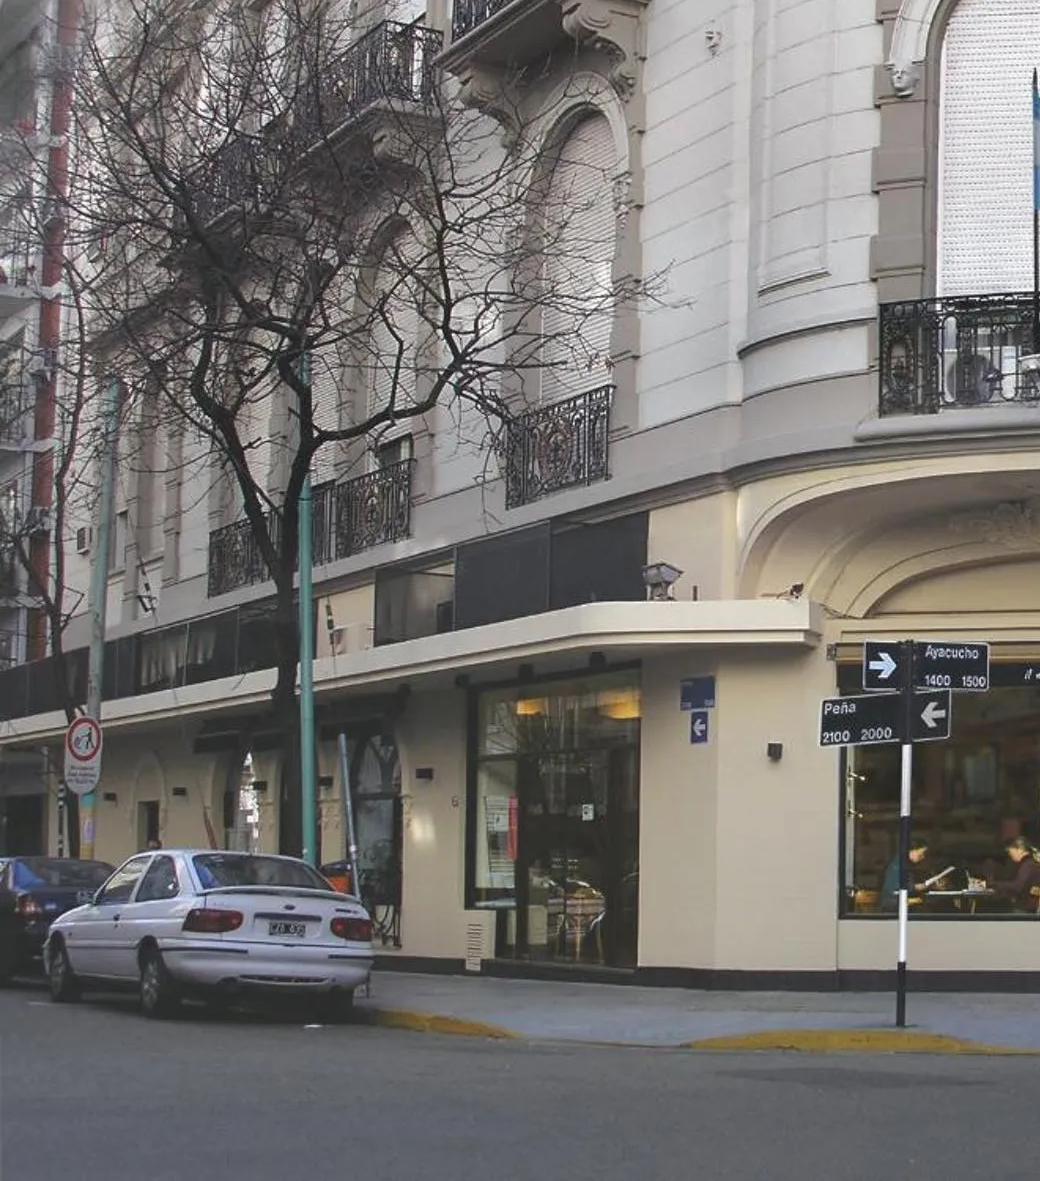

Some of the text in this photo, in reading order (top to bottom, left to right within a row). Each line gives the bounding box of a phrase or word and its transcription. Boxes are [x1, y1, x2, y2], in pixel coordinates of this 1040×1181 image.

[925, 645, 979, 660] Ayacucho
[924, 674, 987, 687] 1400 1500
[824, 702, 857, 715] Peña
[822, 727, 892, 743] 2100 2000
